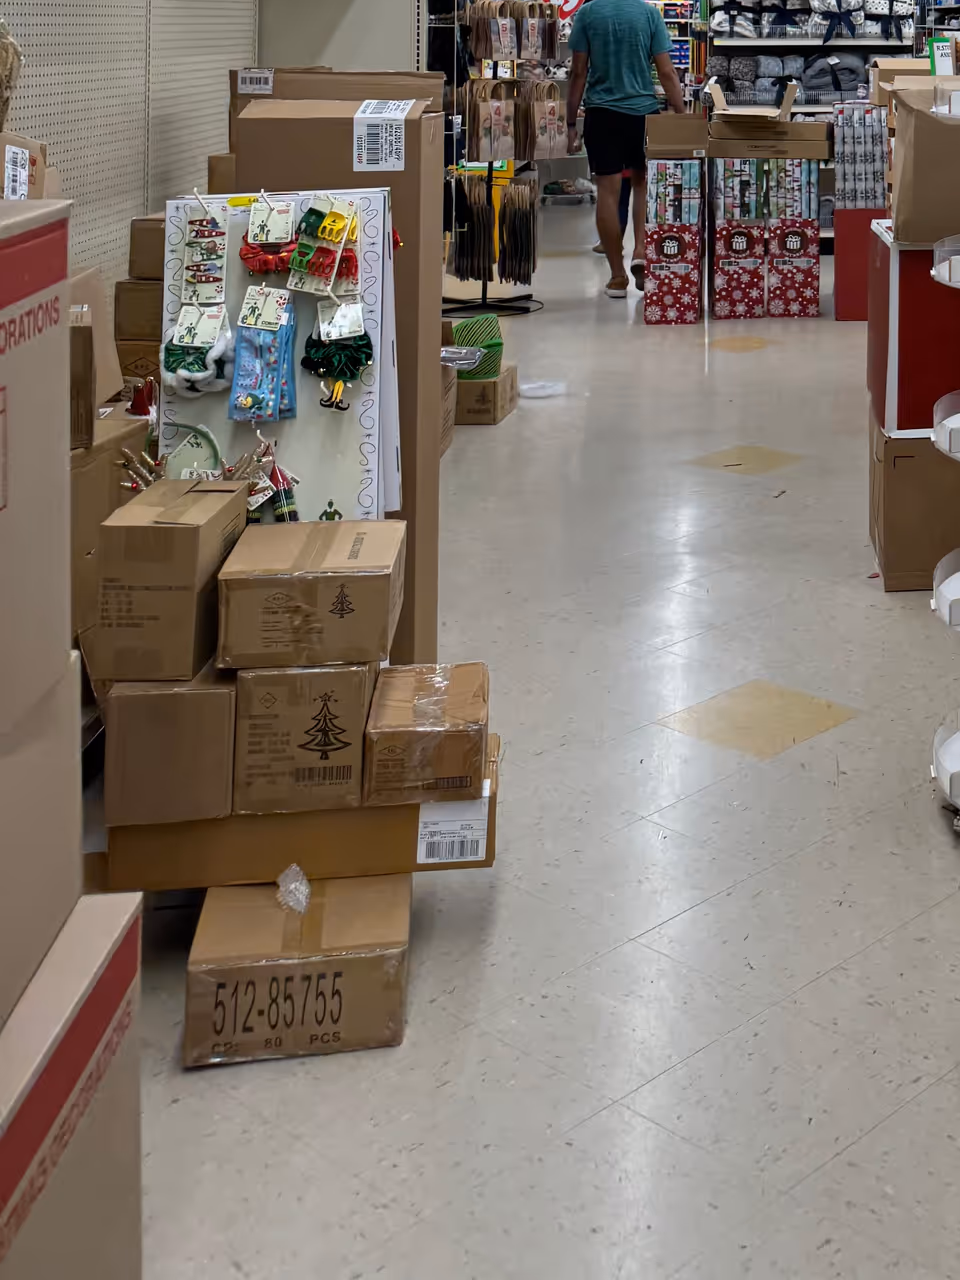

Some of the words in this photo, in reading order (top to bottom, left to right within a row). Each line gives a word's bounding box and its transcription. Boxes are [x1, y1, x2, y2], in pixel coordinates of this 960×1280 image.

[213, 971, 344, 1037] 512-85755
[263, 1036, 283, 1049] 80
[309, 1030, 342, 1046] PCS
